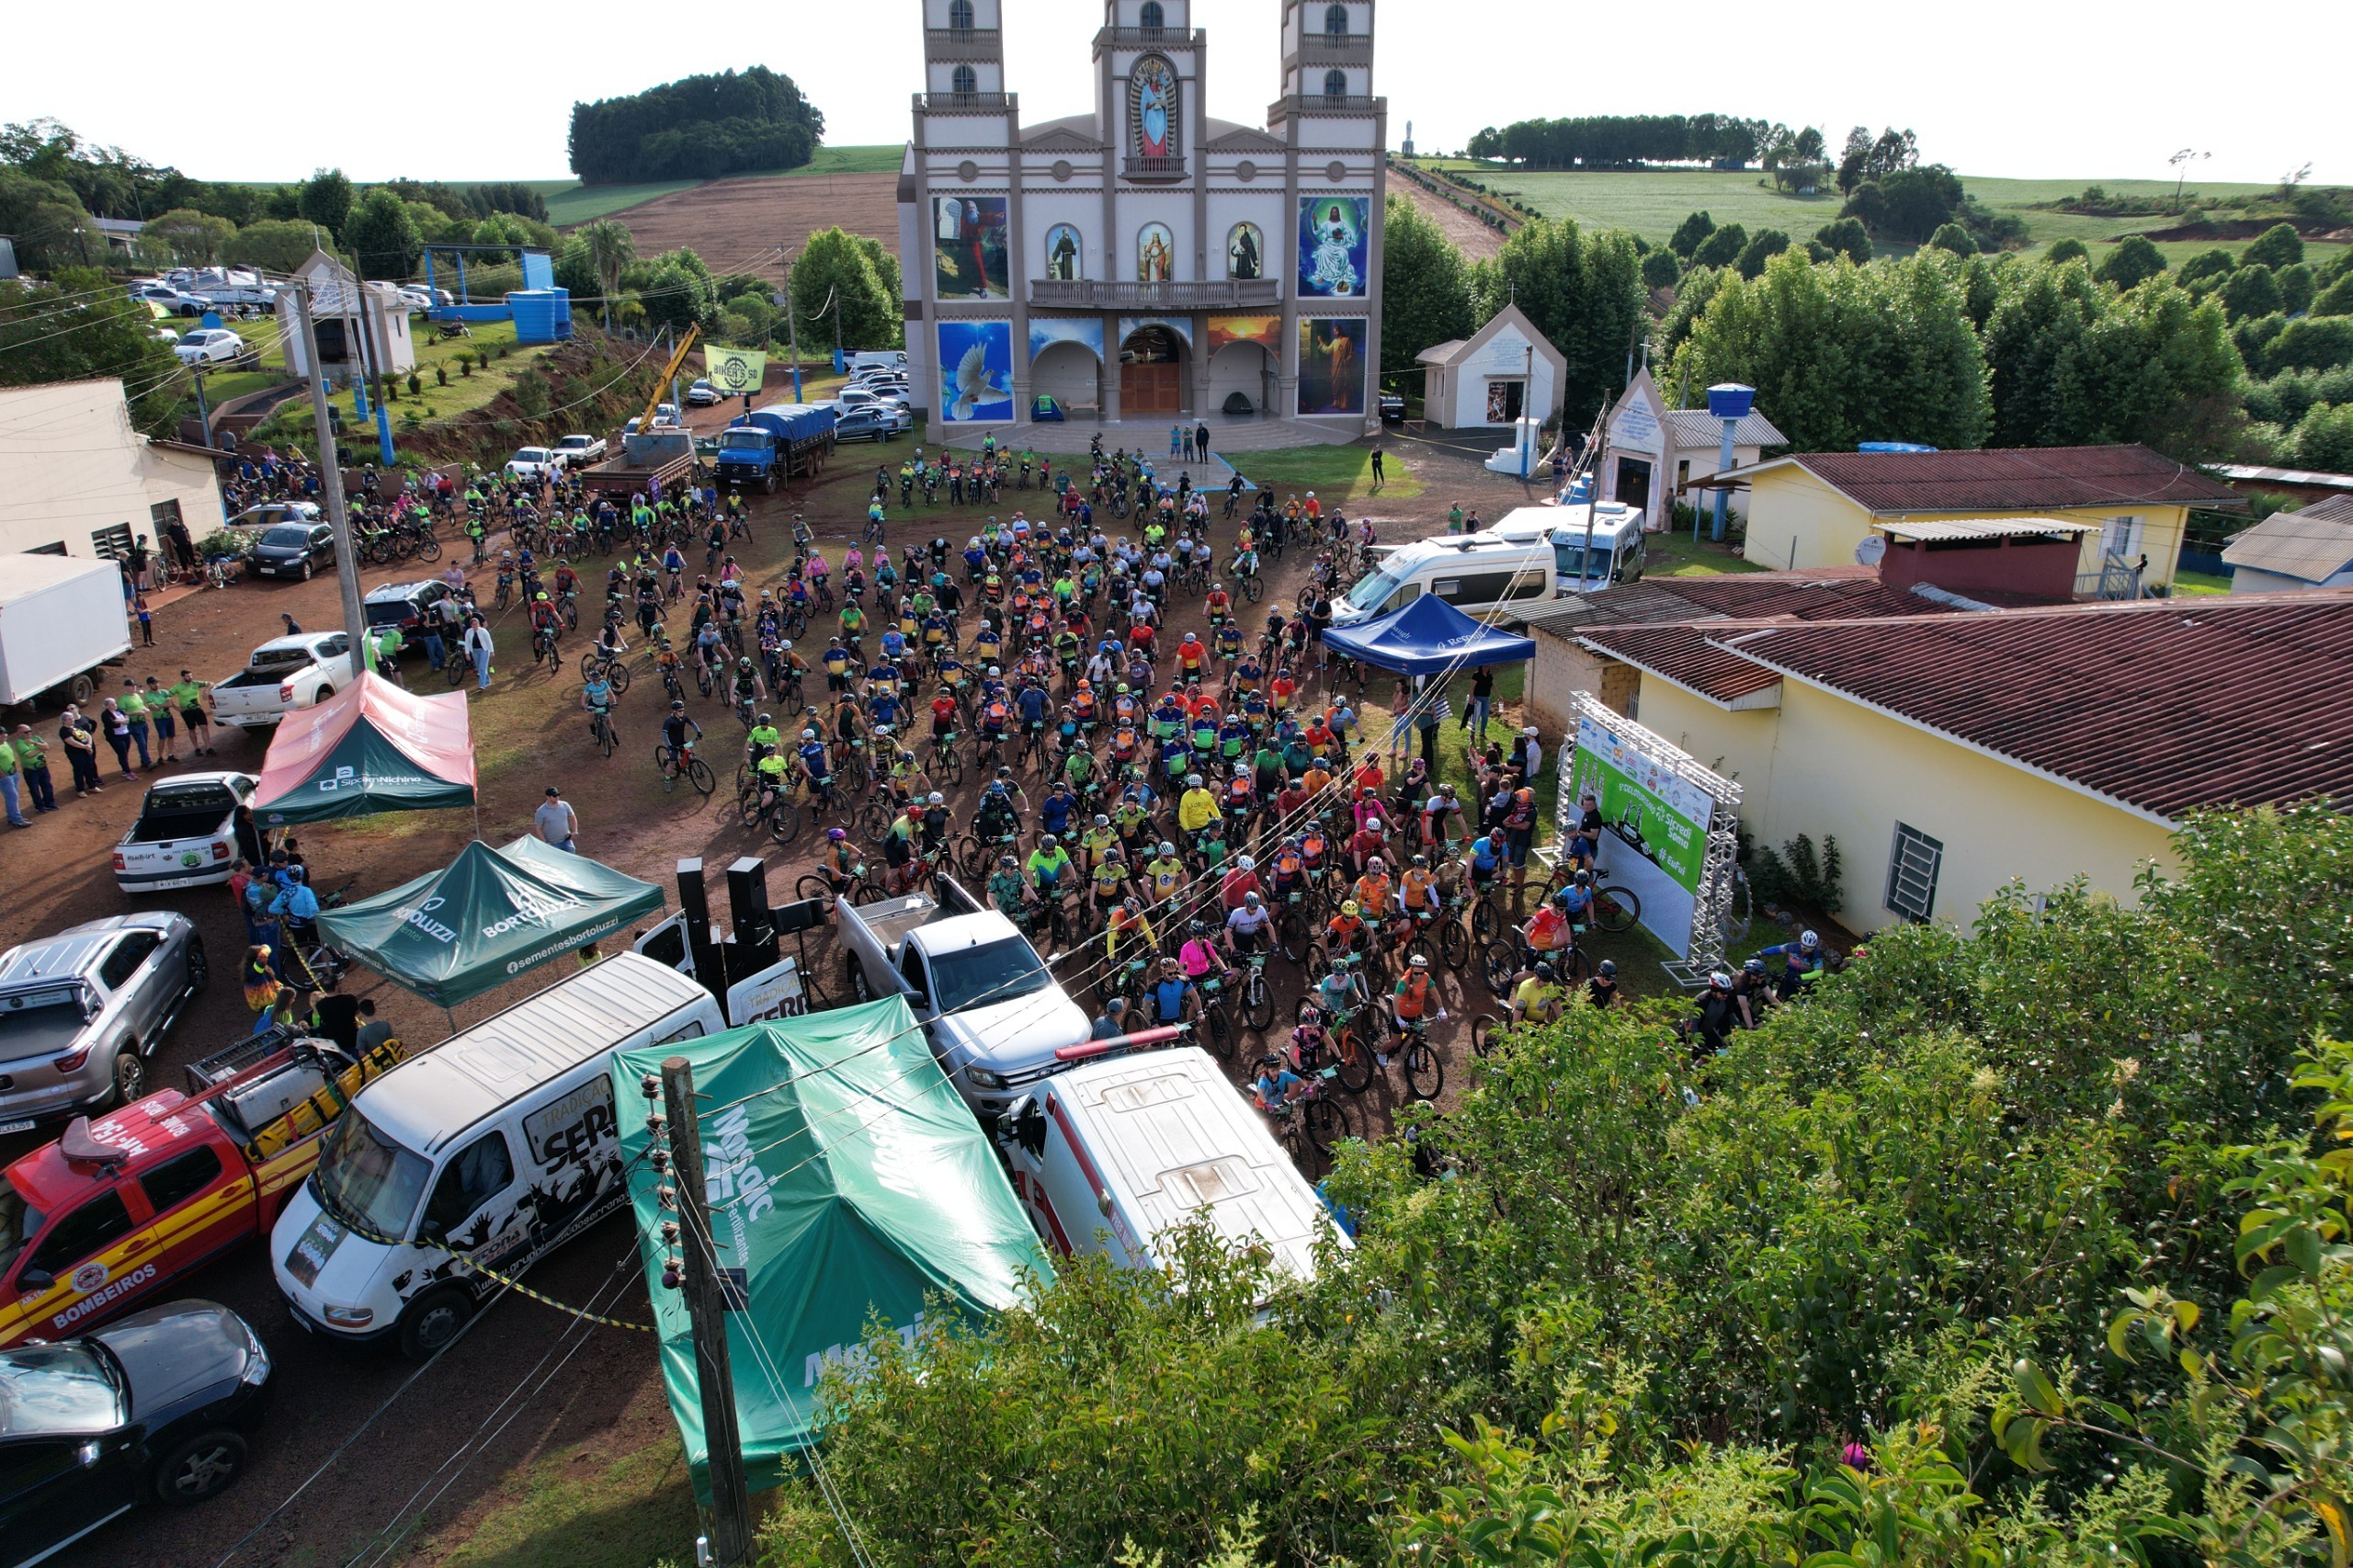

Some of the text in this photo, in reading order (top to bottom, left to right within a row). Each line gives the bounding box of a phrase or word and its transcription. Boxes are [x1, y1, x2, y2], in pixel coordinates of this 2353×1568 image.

[713, 364, 757, 379] BIKER'S SD
[1665, 813, 1692, 840] Sicredi
[1667, 827, 1689, 849] Soma
[1667, 856, 1686, 876] EuFui
[517, 915, 620, 971] sementesbortoluzzi
[712, 1104, 778, 1222] Mosaic
[729, 1202, 751, 1266] Fertilizantes
[52, 1264, 157, 1329] BOMBEIROS
